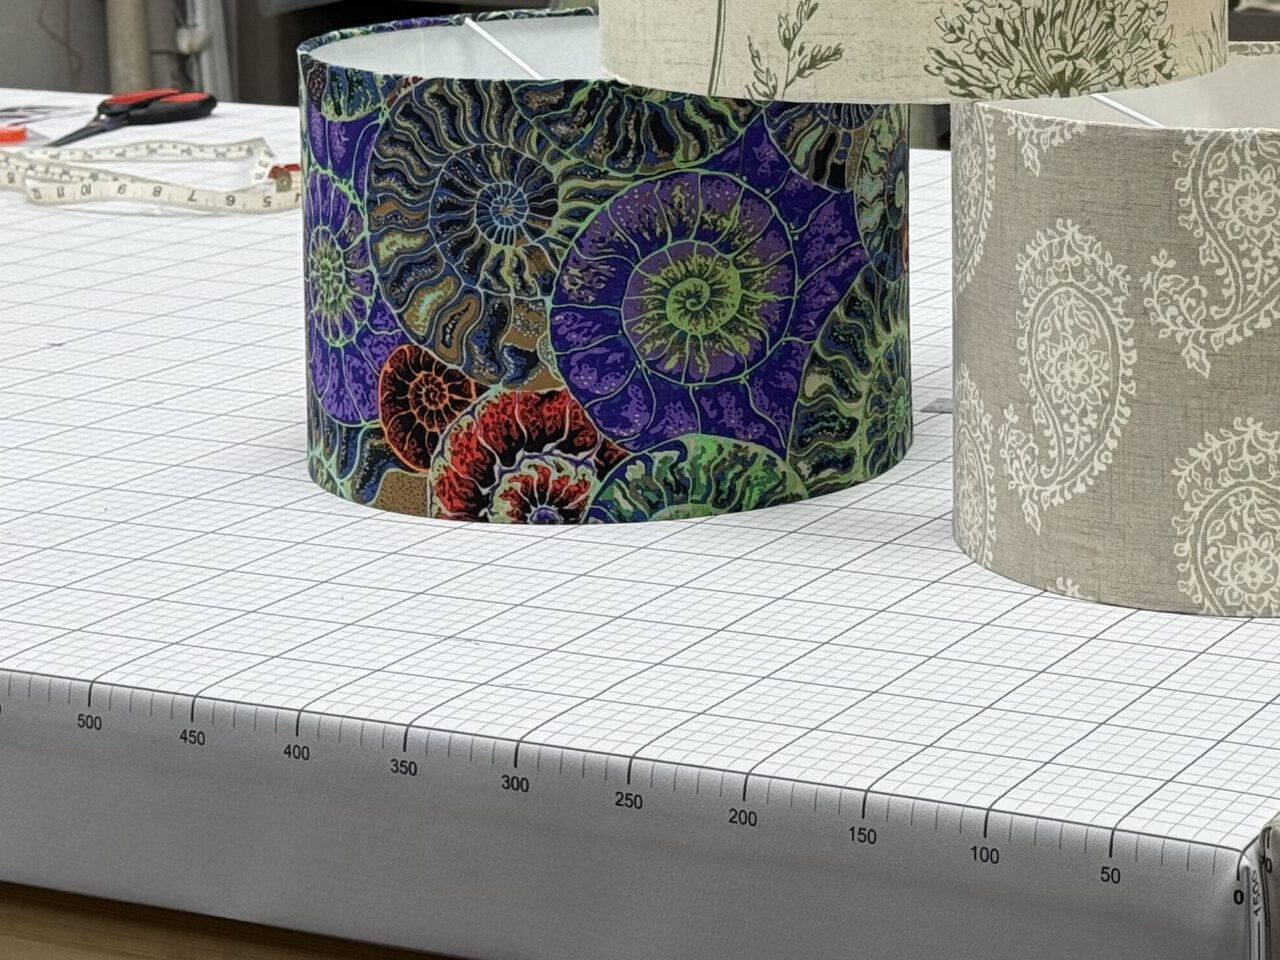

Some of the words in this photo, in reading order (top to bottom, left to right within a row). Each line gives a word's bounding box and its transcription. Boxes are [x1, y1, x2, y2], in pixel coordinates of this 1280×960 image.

[80, 183, 92, 196] 10
[187, 189, 197, 202] 7
[225, 195, 236, 207] 6
[262, 196, 272, 208] 5
[77, 713, 103, 731] 500
[179, 728, 206, 746] 450
[283, 743, 310, 762] 400
[390, 758, 418, 777] 350
[501, 774, 530, 793] 300
[614, 790, 643, 810] 250
[728, 807, 758, 827] 200
[848, 825, 877, 845] 150
[970, 845, 1000, 865] 100
[1100, 865, 1121, 885] 50
[1233, 889, 1245, 906] 0
